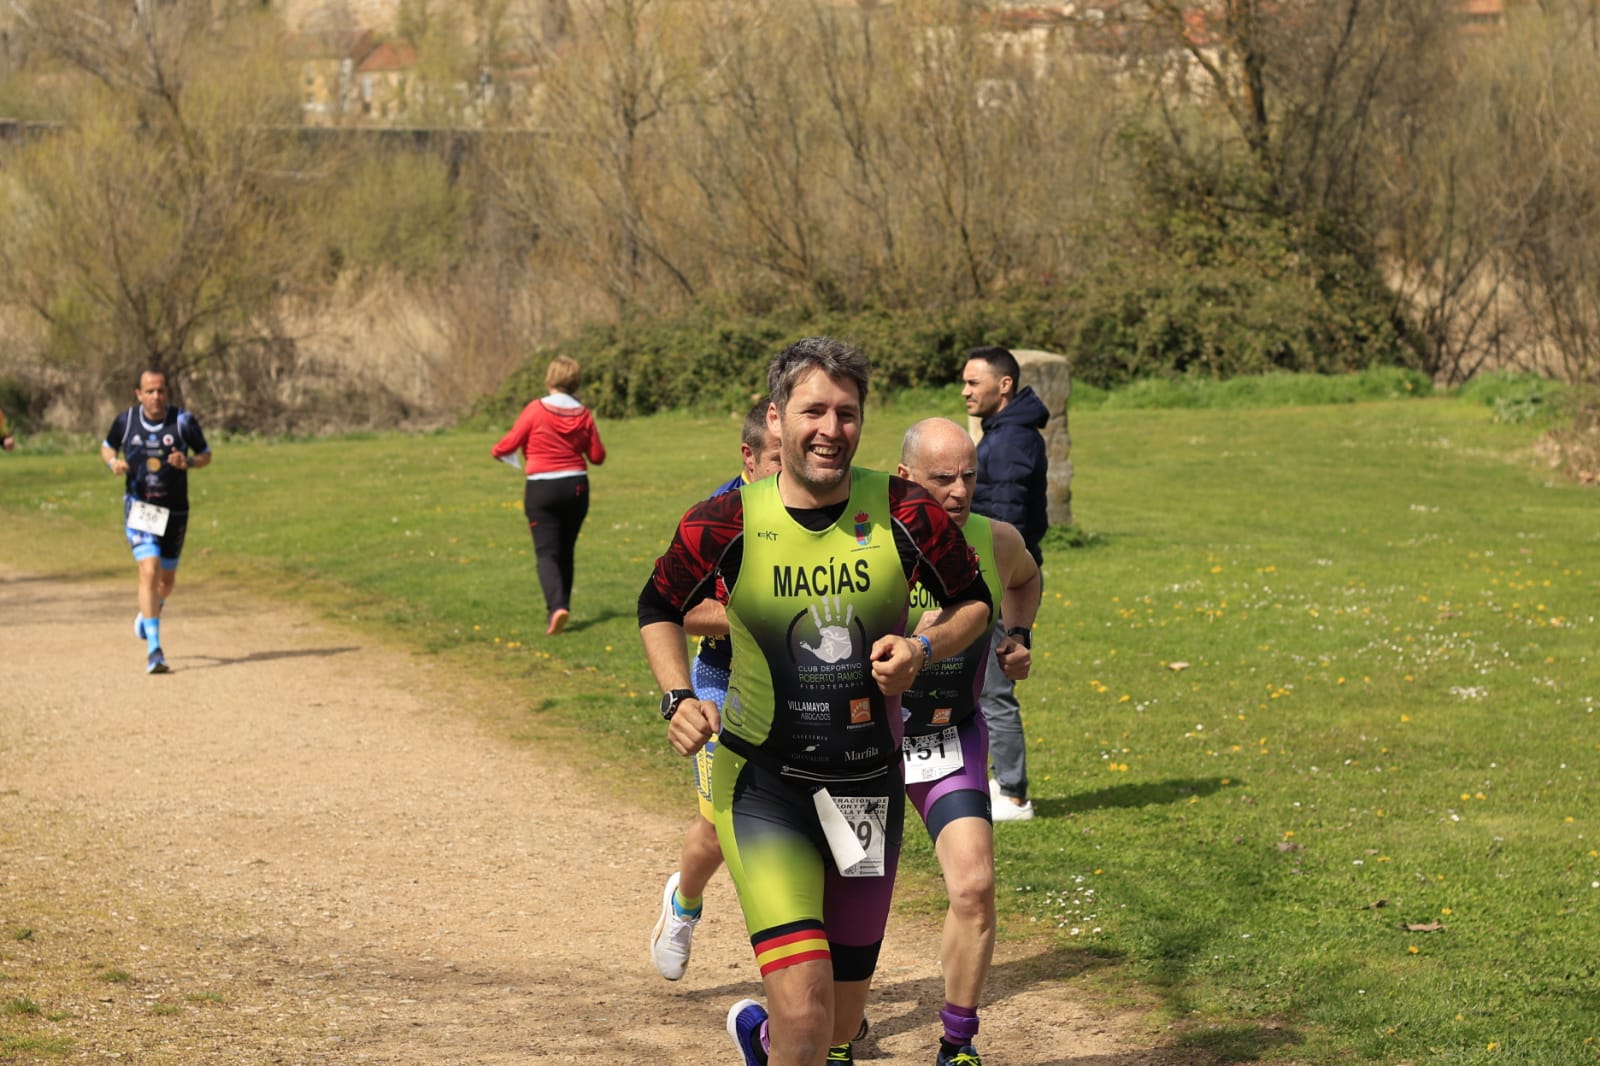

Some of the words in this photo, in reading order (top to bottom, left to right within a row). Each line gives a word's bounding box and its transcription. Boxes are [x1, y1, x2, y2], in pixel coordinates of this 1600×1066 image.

[773, 556, 871, 597] MACÍAS
[798, 665, 818, 673] CLUB
[820, 662, 862, 672] DEPORTIVO
[941, 662, 964, 671] RAMOS
[799, 673, 835, 683] ROBERTO
[837, 670, 864, 681] RAMOS
[787, 700, 830, 713] VILLAMAYOR
[800, 712, 831, 721] ABOGADOS
[901, 742, 946, 762] 151
